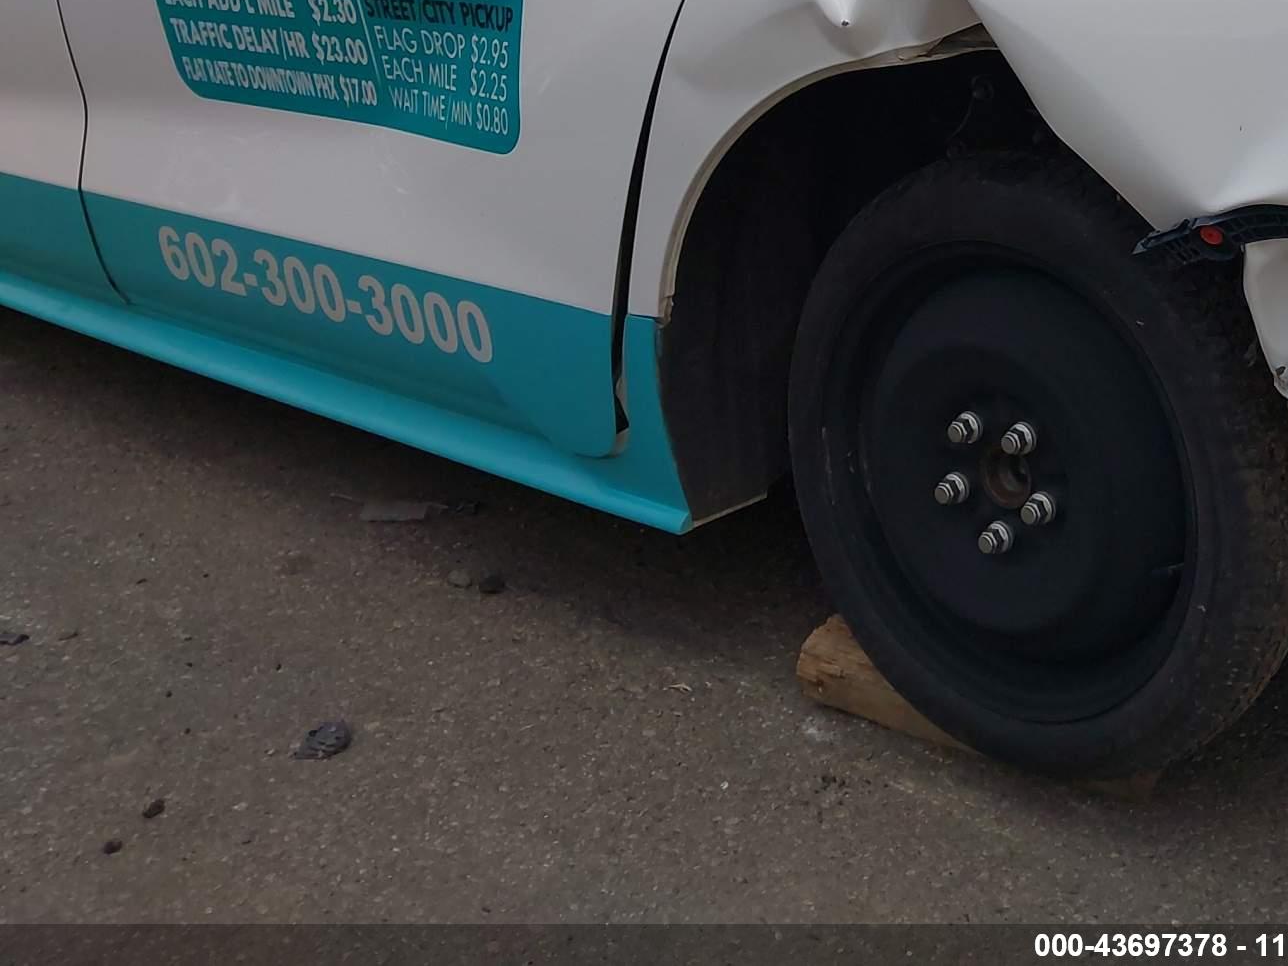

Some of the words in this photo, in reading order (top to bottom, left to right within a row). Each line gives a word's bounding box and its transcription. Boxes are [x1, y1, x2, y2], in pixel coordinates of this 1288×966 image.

[169, 17, 233, 50] TRAFFIC
[311, 31, 369, 65] $23.00
[459, 2, 514, 32] PICKUP
[373, 25, 418, 54] FLAG
[420, 30, 466, 59] DROP
[470, 34, 509, 69] $2.95
[182, 56, 208, 83] FLAT
[206, 59, 235, 86] RATE
[231, 62, 249, 89] TO
[248, 65, 316, 97] DOWNTOWN
[313, 73, 340, 101] PHX
[338, 74, 378, 107] $17.00
[381, 55, 424, 84] EACH
[428, 63, 457, 91] MILE
[470, 65, 508, 102] $2.25
[388, 86, 419, 114] WAIT
[476, 102, 509, 135] $0.80
[158, 225, 493, 363] 602-300-3000
